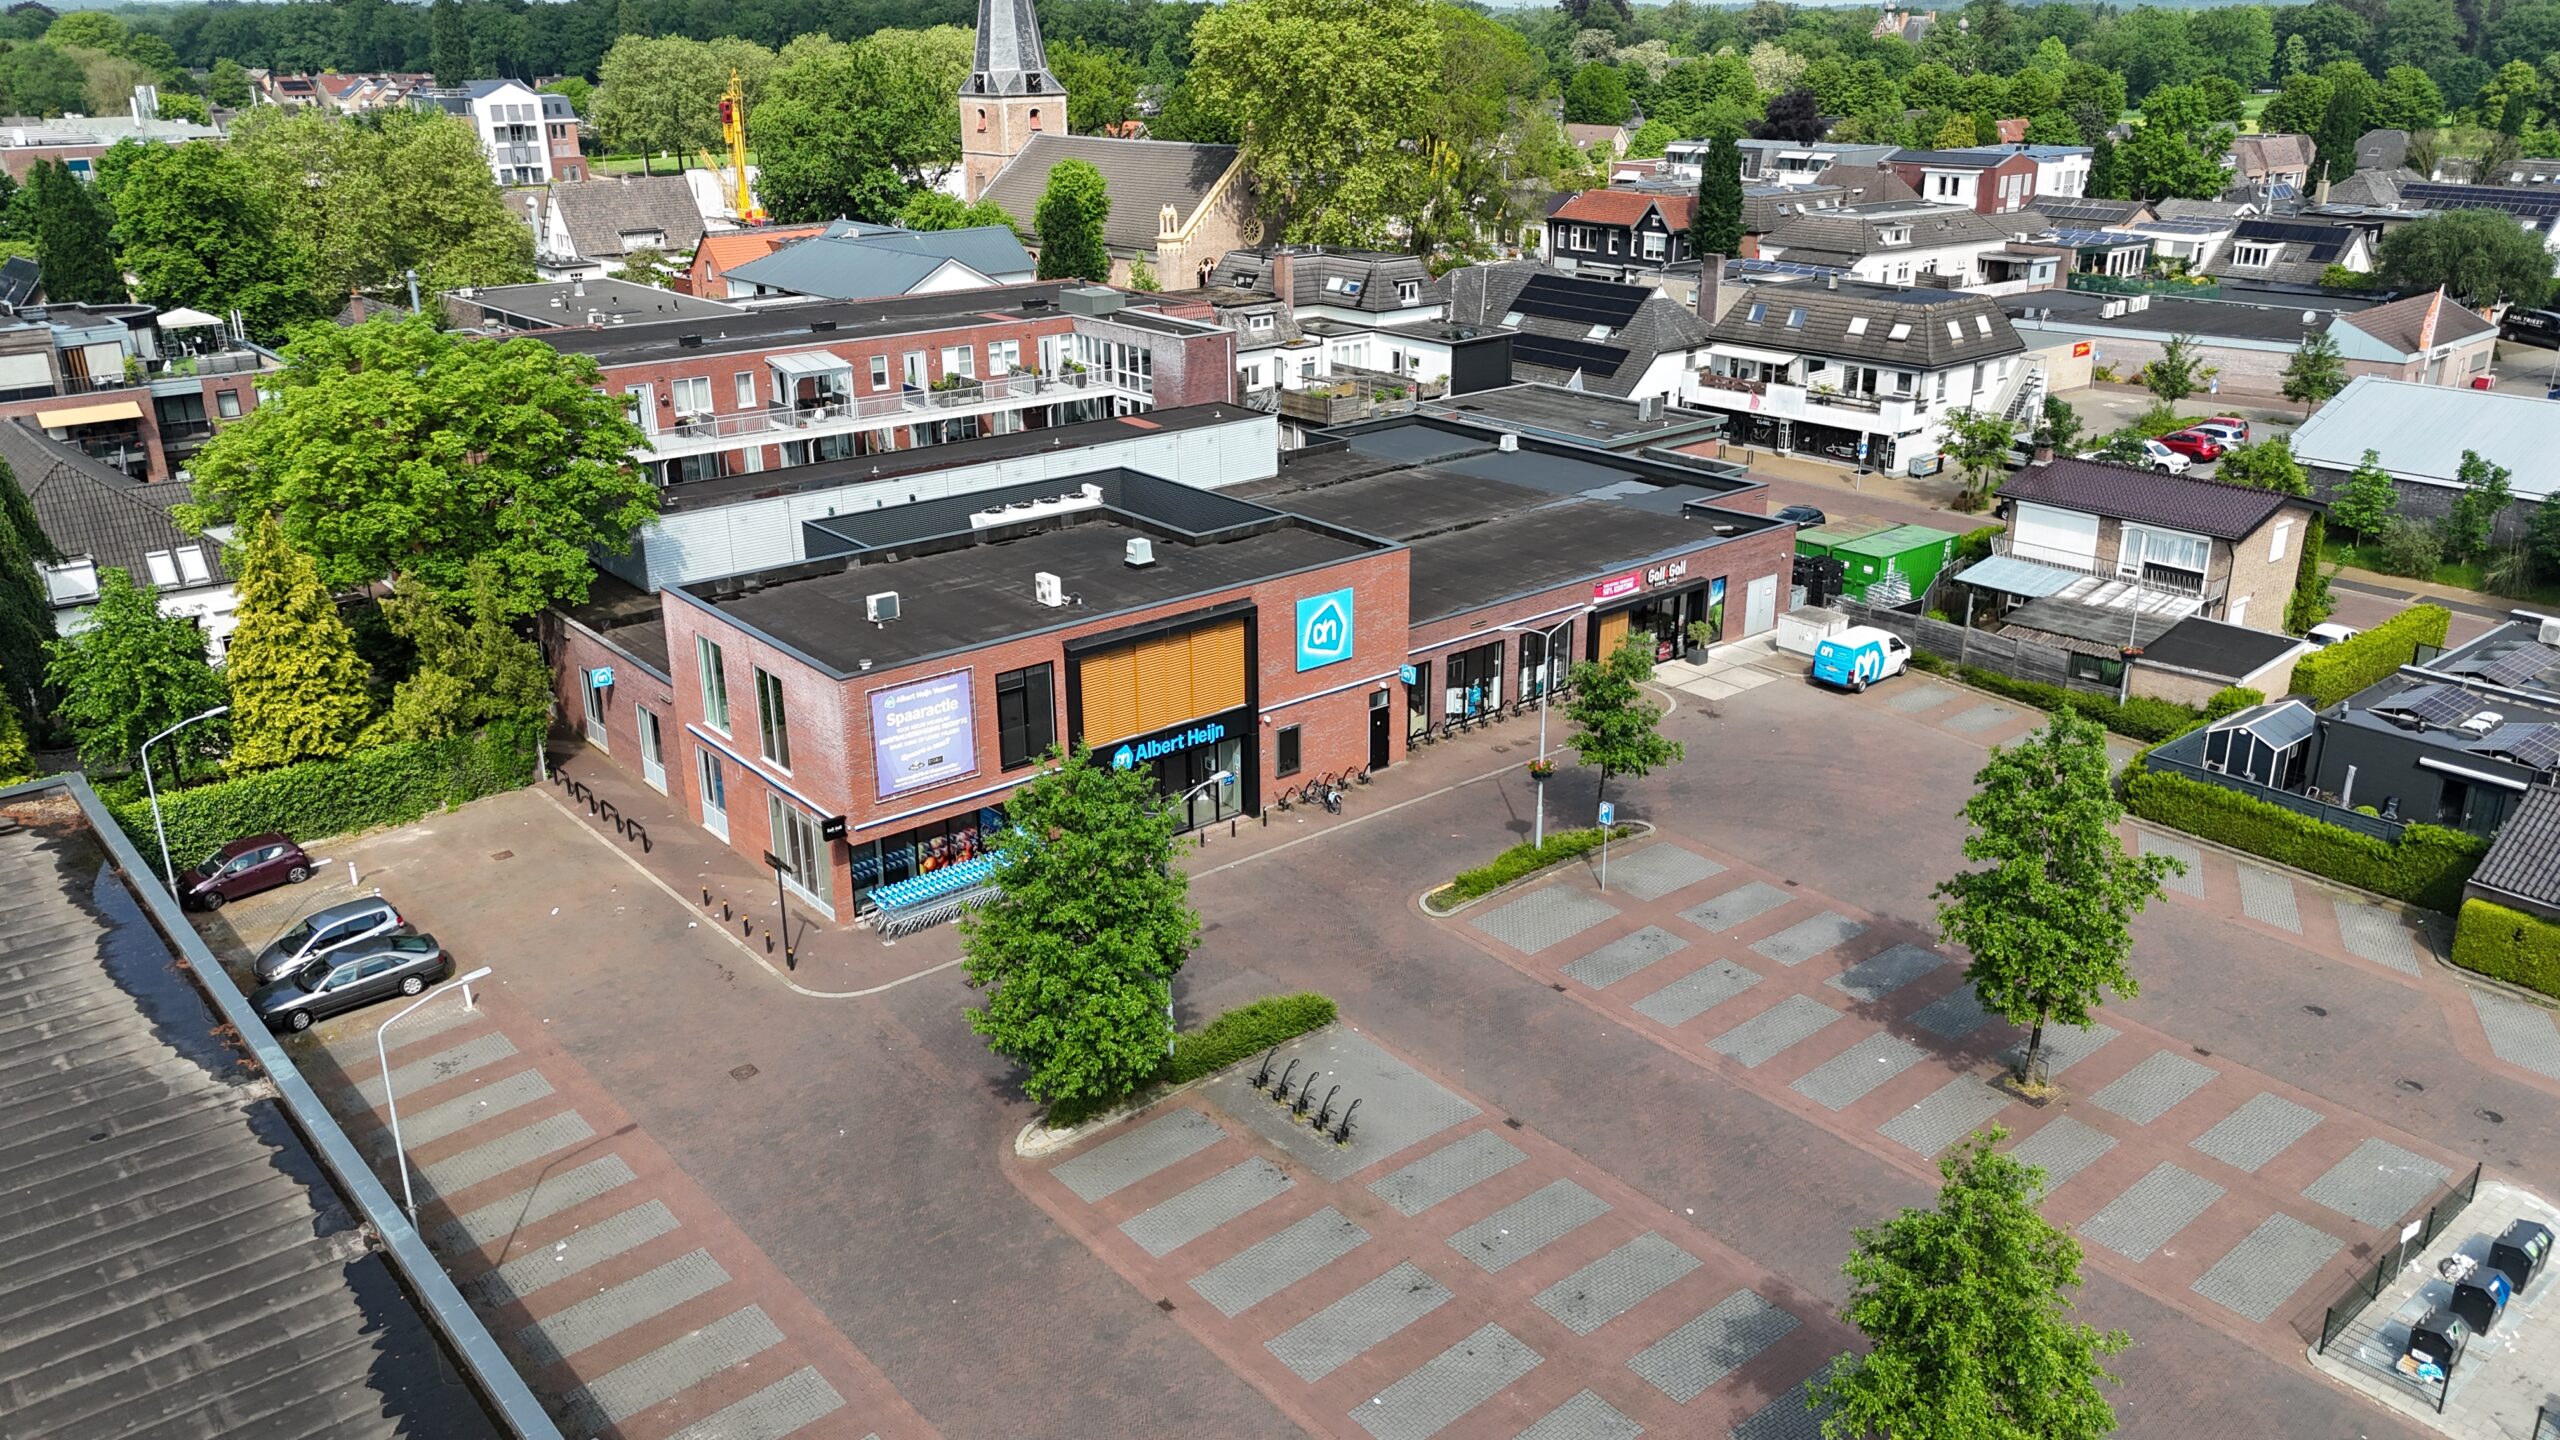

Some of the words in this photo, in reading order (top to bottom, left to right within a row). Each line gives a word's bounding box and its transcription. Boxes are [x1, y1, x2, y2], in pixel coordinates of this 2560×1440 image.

[1647, 566, 1666, 583] Gall
[1669, 560, 1686, 578] Gall
[886, 698, 959, 727] Spaaractie
[1135, 734, 1185, 762] Albert
[1187, 723, 1225, 747] Heijn
